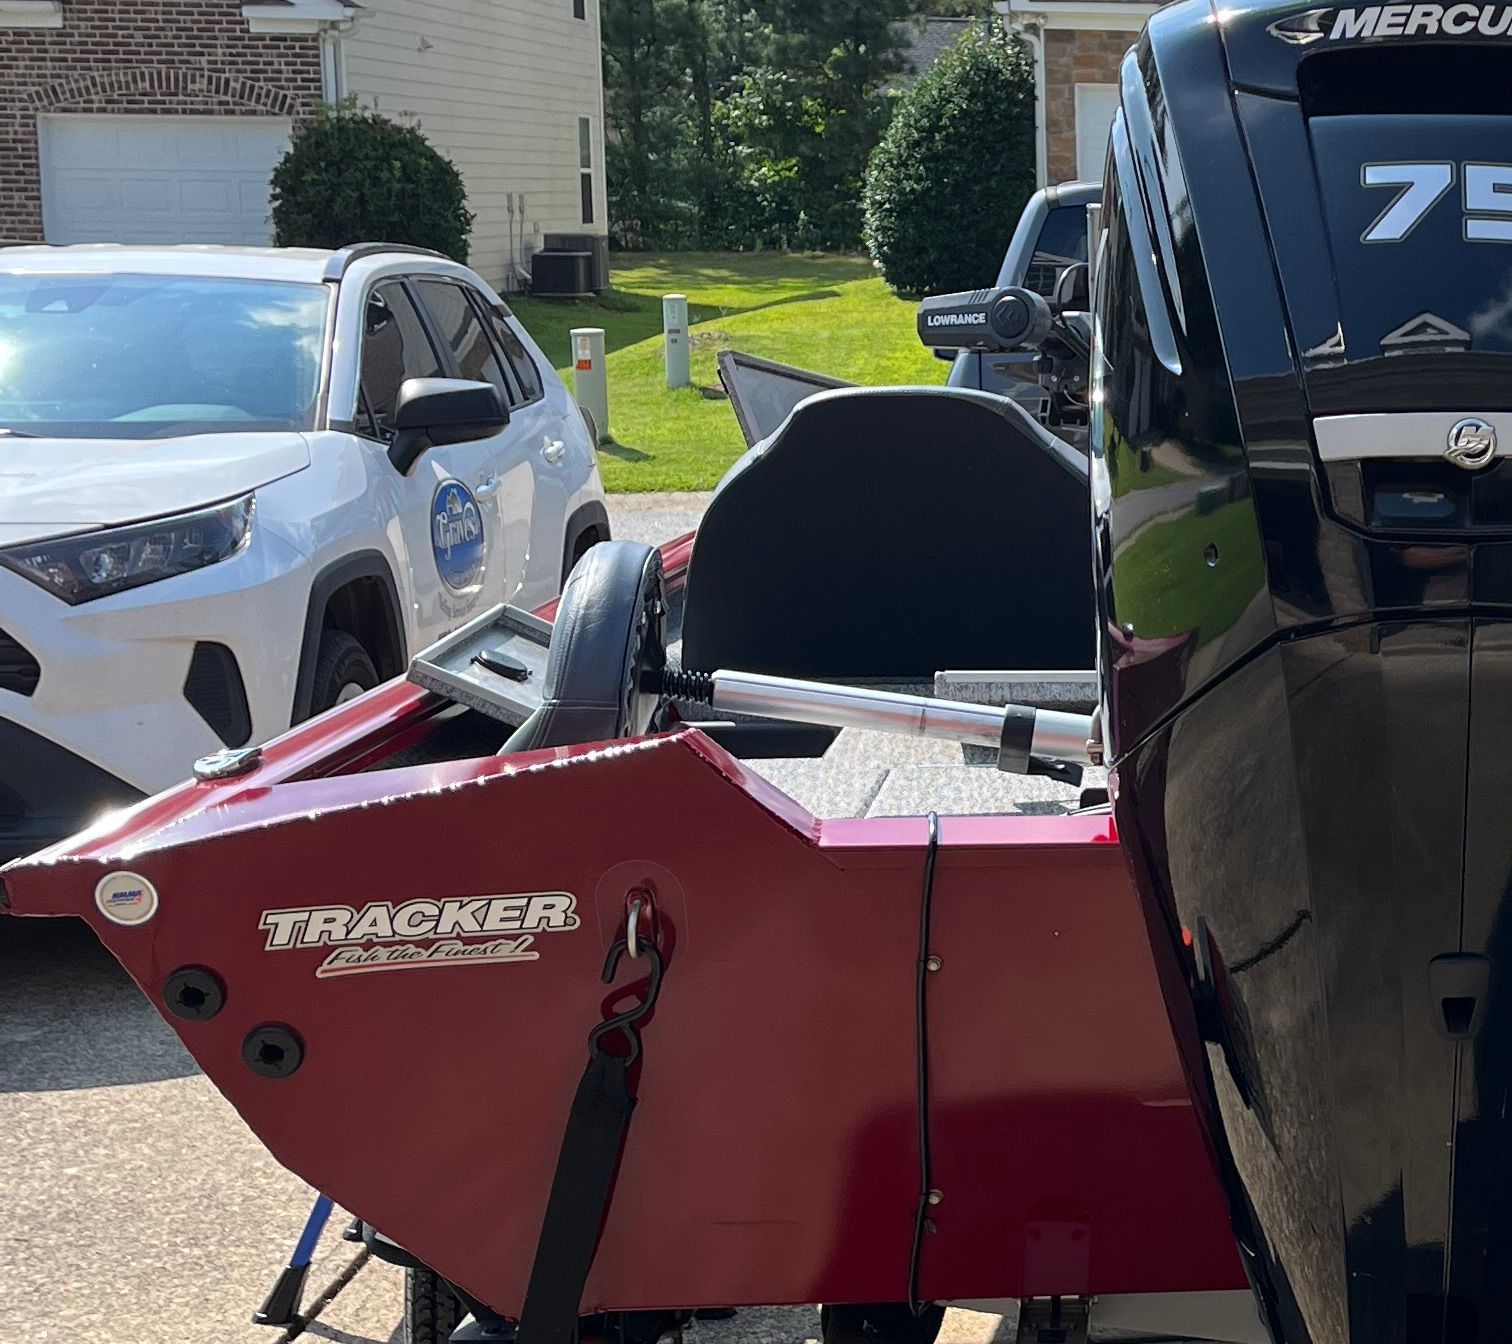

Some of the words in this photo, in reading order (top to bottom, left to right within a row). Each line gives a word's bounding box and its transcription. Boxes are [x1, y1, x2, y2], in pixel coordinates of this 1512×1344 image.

[927, 312, 987, 327] LOWRANCE
[262, 893, 574, 948] TRACKER
[327, 948, 380, 966] Fish
[385, 944, 424, 962] the
